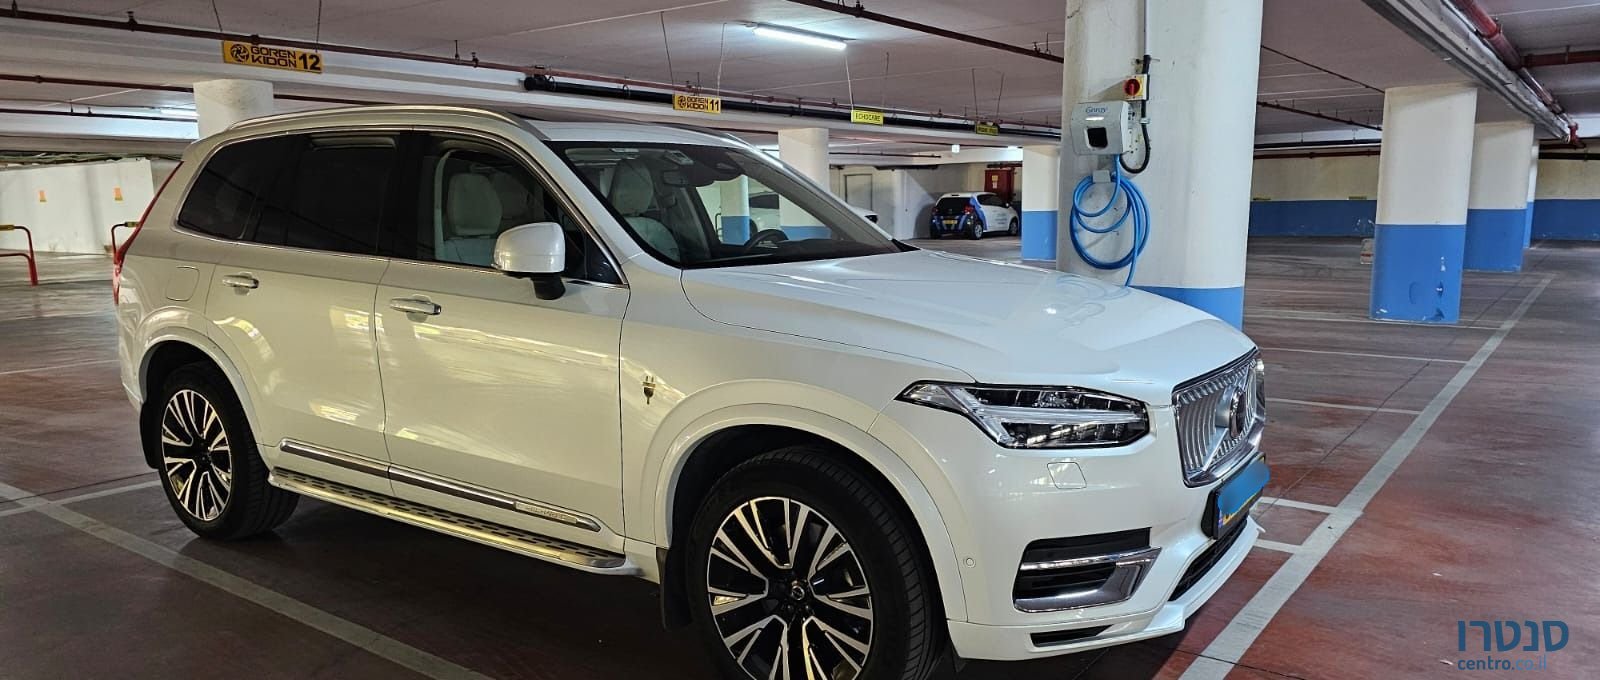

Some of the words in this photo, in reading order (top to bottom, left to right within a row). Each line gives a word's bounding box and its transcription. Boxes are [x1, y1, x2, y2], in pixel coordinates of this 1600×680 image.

[251, 46, 296, 60] GOREN
[251, 55, 297, 68] KIDON
[298, 53, 321, 71] 12
[709, 99, 719, 111] 11
